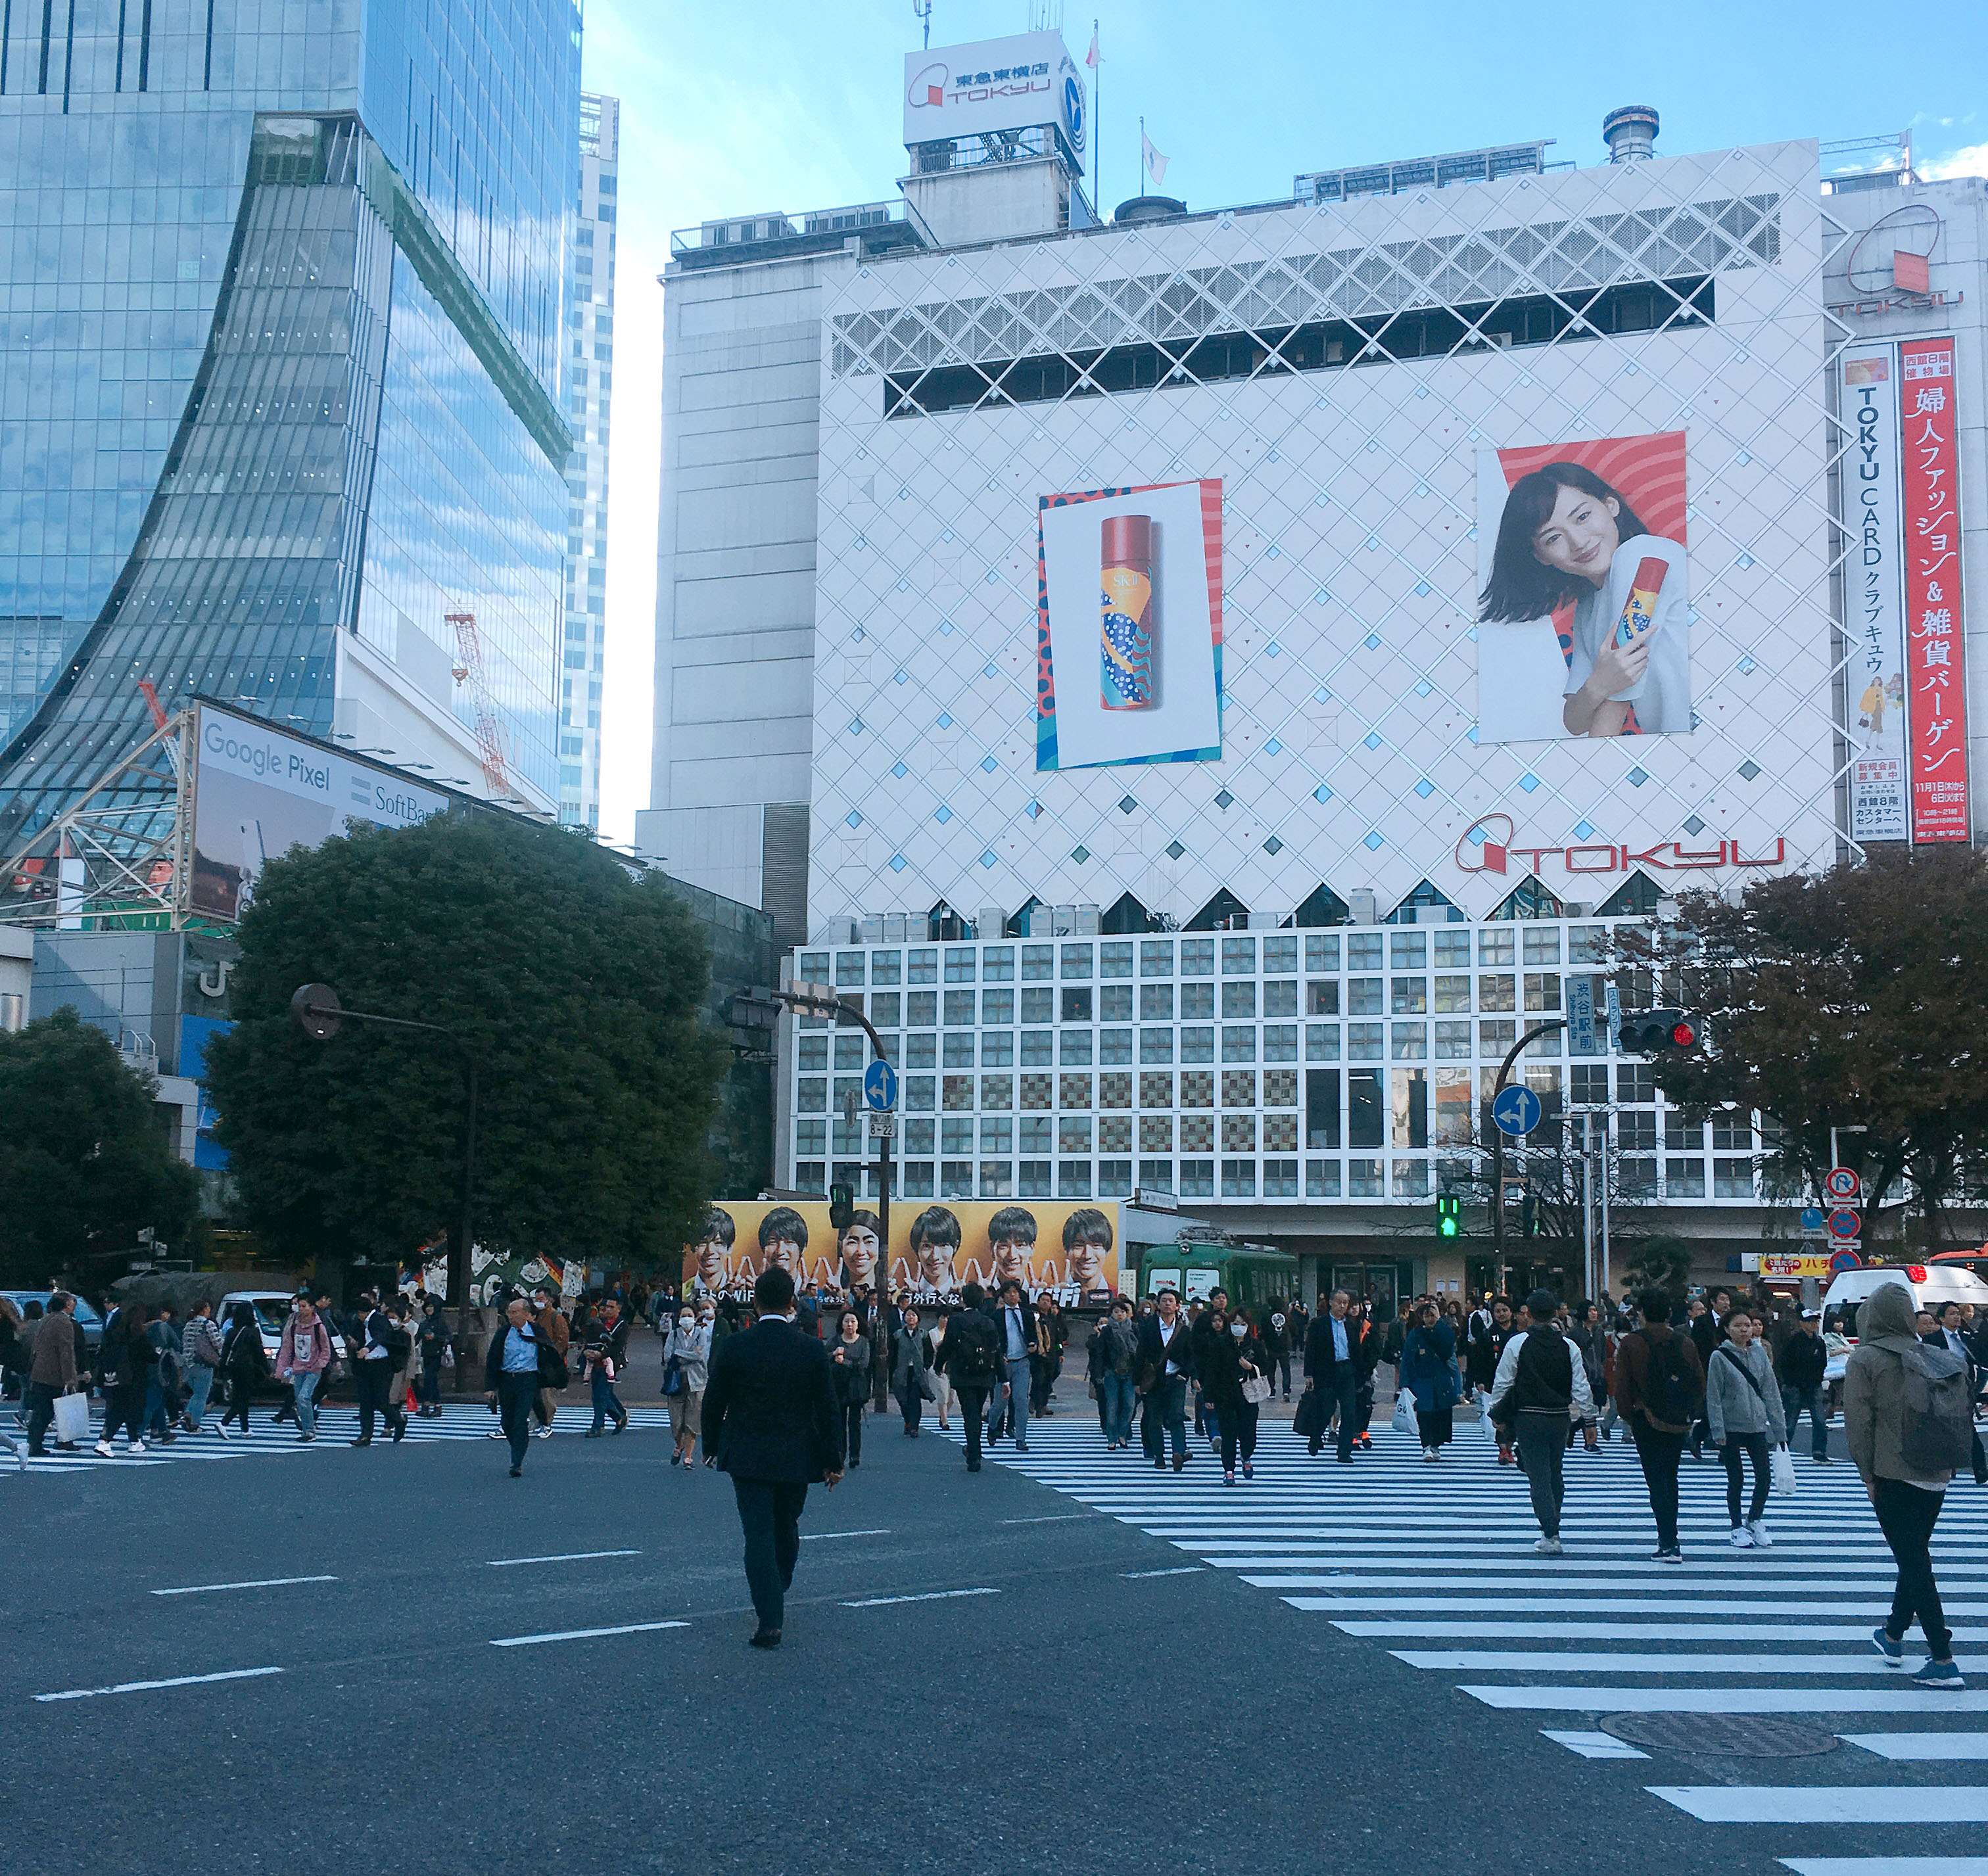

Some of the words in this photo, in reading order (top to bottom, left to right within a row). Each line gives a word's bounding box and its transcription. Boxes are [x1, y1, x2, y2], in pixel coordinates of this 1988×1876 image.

[947, 78, 1051, 104] TOKYU
[955, 62, 1049, 88] 東急東横店
[1828, 291, 1964, 318] TOKYU
[204, 723, 282, 776] Google
[289, 754, 329, 791] Pixel
[376, 786, 438, 824] SoftBa
[1510, 837, 1784, 875] TOKYU
[1576, 983, 1592, 1049] 渋谷駅前
[905, 1292, 963, 1305] 外行くな
